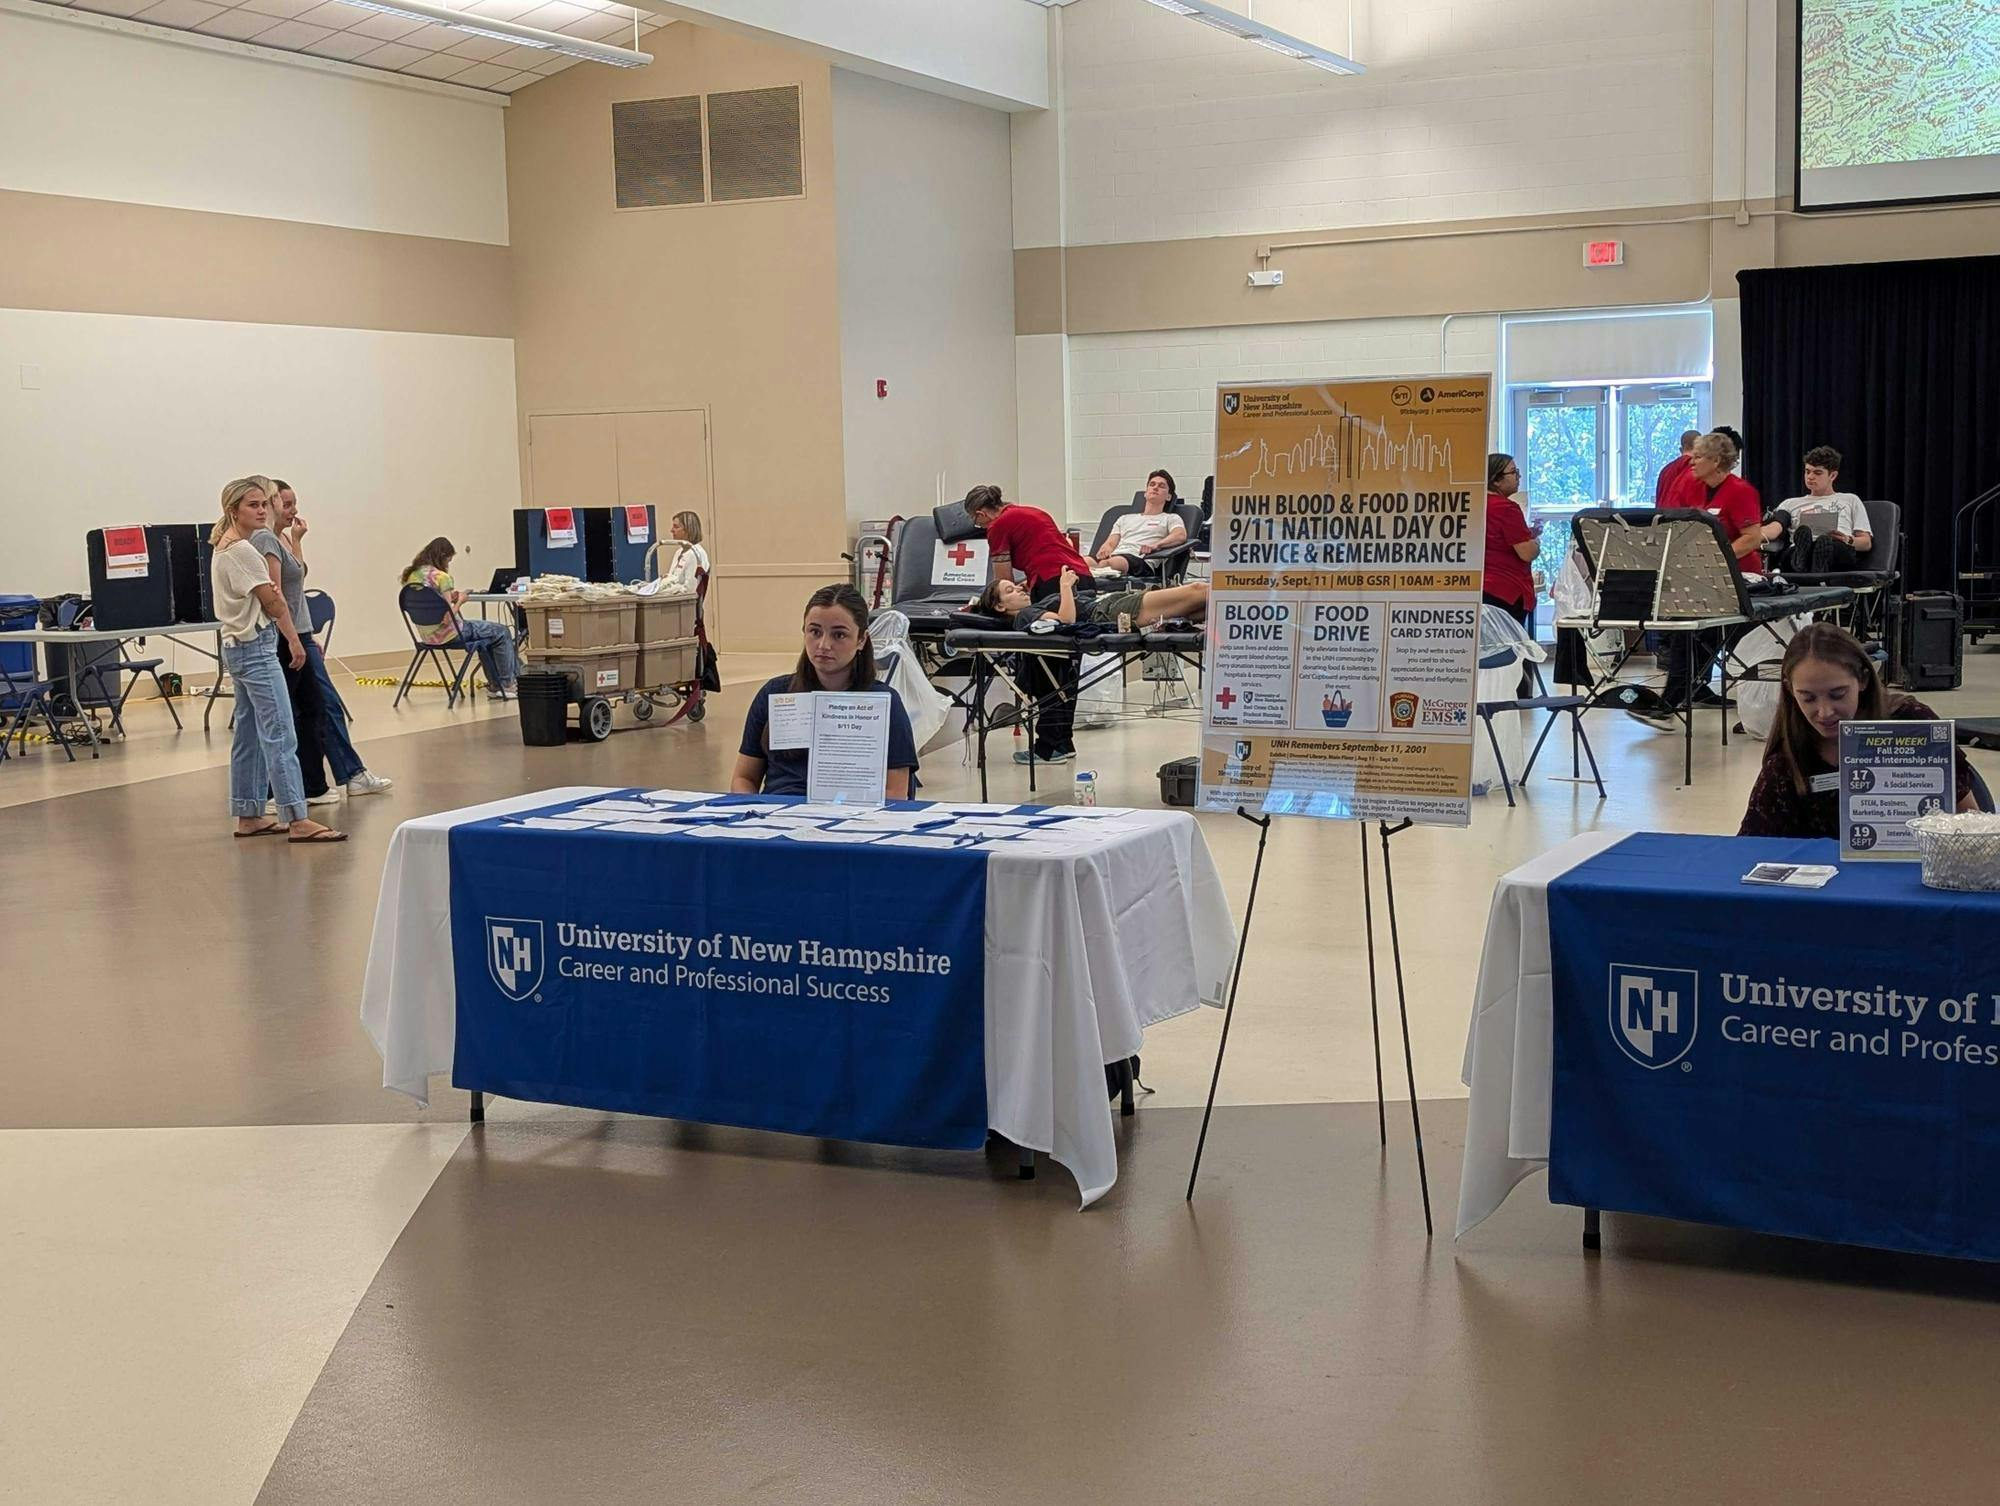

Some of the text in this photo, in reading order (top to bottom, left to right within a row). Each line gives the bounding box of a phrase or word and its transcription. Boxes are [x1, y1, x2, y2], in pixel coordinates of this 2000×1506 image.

[1243, 393, 1290, 403] University of
[1438, 390, 1485, 399] AmeriCorps
[1261, 402, 1302, 411] Hampshire
[1274, 409, 1309, 417] Professional
[1310, 408, 1333, 416] Success
[1231, 491, 1471, 515] UNH BLOOD & FOOD DRIVE
[1229, 514, 1467, 541] 9/11 NATIONAL DAY OF
[1228, 542, 1467, 564] SERVICE & REMEMBRANCE
[1225, 575, 1471, 588] Thursday, Sept. 11 MUB GSR 10AM 3PM
[1225, 605, 1289, 621] BLOOD
[1315, 605, 1369, 622] FOOD
[1391, 610, 1475, 624] KINDNESS
[1229, 624, 1283, 640] DRIVE
[1313, 625, 1370, 642] DRIVE
[1391, 627, 1474, 639] CARD STATION
[1352, 646, 1379, 654] insecurity
[828, 704, 848, 712] Pledge
[1423, 698, 1468, 709] McGregor
[1422, 711, 1453, 723] EMS
[1866, 737, 1927, 746] NEXT WEEK!
[1270, 740, 1427, 755] UNH Remembers September 11, 2001
[1877, 746, 1915, 755] Fall 2025
[1844, 756, 1949, 766] Career & Internship Fairs
[1852, 770, 1868, 781] 17
[1891, 771, 1926, 779] Healthcare
[1230, 777, 1254, 786] Library
[1850, 781, 1871, 790] SEPT
[1890, 781, 1908, 789] Social
[1909, 781, 1934, 789] Services
[1417, 800, 1438, 808] engage
[1924, 798, 1941, 809] 18
[1852, 809, 1886, 818] Marketing,
[1893, 809, 1917, 817] Finance
[1854, 826, 1871, 837] 19
[1852, 838, 1873, 847] SEPT
[556, 922, 951, 976] University of New Hampshire
[558, 956, 891, 1003] Career and Professional Success
[1720, 972, 1929, 1025] University
[1938, 992, 1979, 1024] of
[1720, 1015, 1821, 1048] Career
[1829, 1028, 1889, 1055] and
